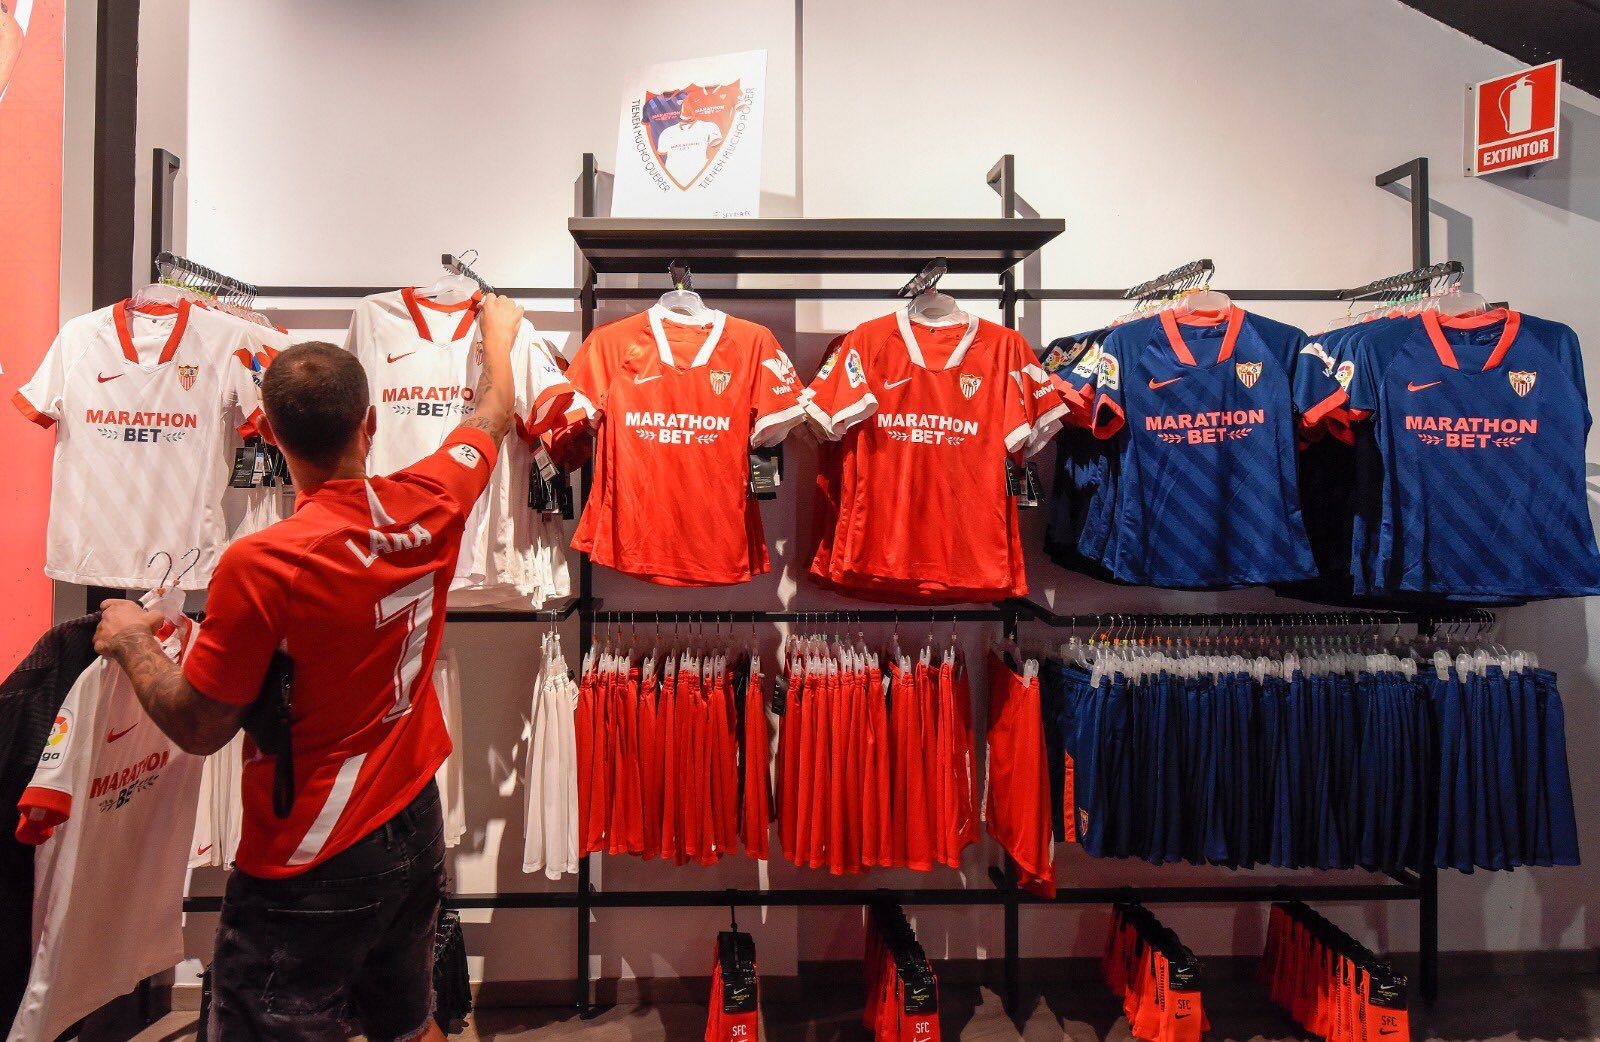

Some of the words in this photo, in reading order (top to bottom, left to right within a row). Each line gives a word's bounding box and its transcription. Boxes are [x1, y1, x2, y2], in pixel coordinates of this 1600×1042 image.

[631, 99, 641, 129] TIENEN
[634, 130, 650, 162] MUCHO
[699, 160, 726, 189] TIENEN
[722, 122, 746, 160] MUCHO
[1483, 138, 1549, 166] EXTINTOR
[645, 162, 671, 193] QUERER
[382, 386, 475, 403] MARATHO
[85, 409, 197, 429] MARATHON
[625, 411, 730, 431] MARATHON
[877, 413, 979, 436] MARATHON
[1145, 409, 1264, 431] MARATHON
[1405, 416, 1538, 434] MARATHON
[123, 428, 162, 442] BET
[658, 429, 695, 445] BET
[910, 428, 945, 446] BET
[1187, 427, 1227, 446] BET
[1445, 433, 1491, 449] BET
[375, 571, 436, 723] 7
[1178, 998, 1192, 1010] SFC
[732, 1024, 747, 1037] SFC
[915, 1021, 930, 1034] SFC
[1381, 1015, 1398, 1027] SFC
